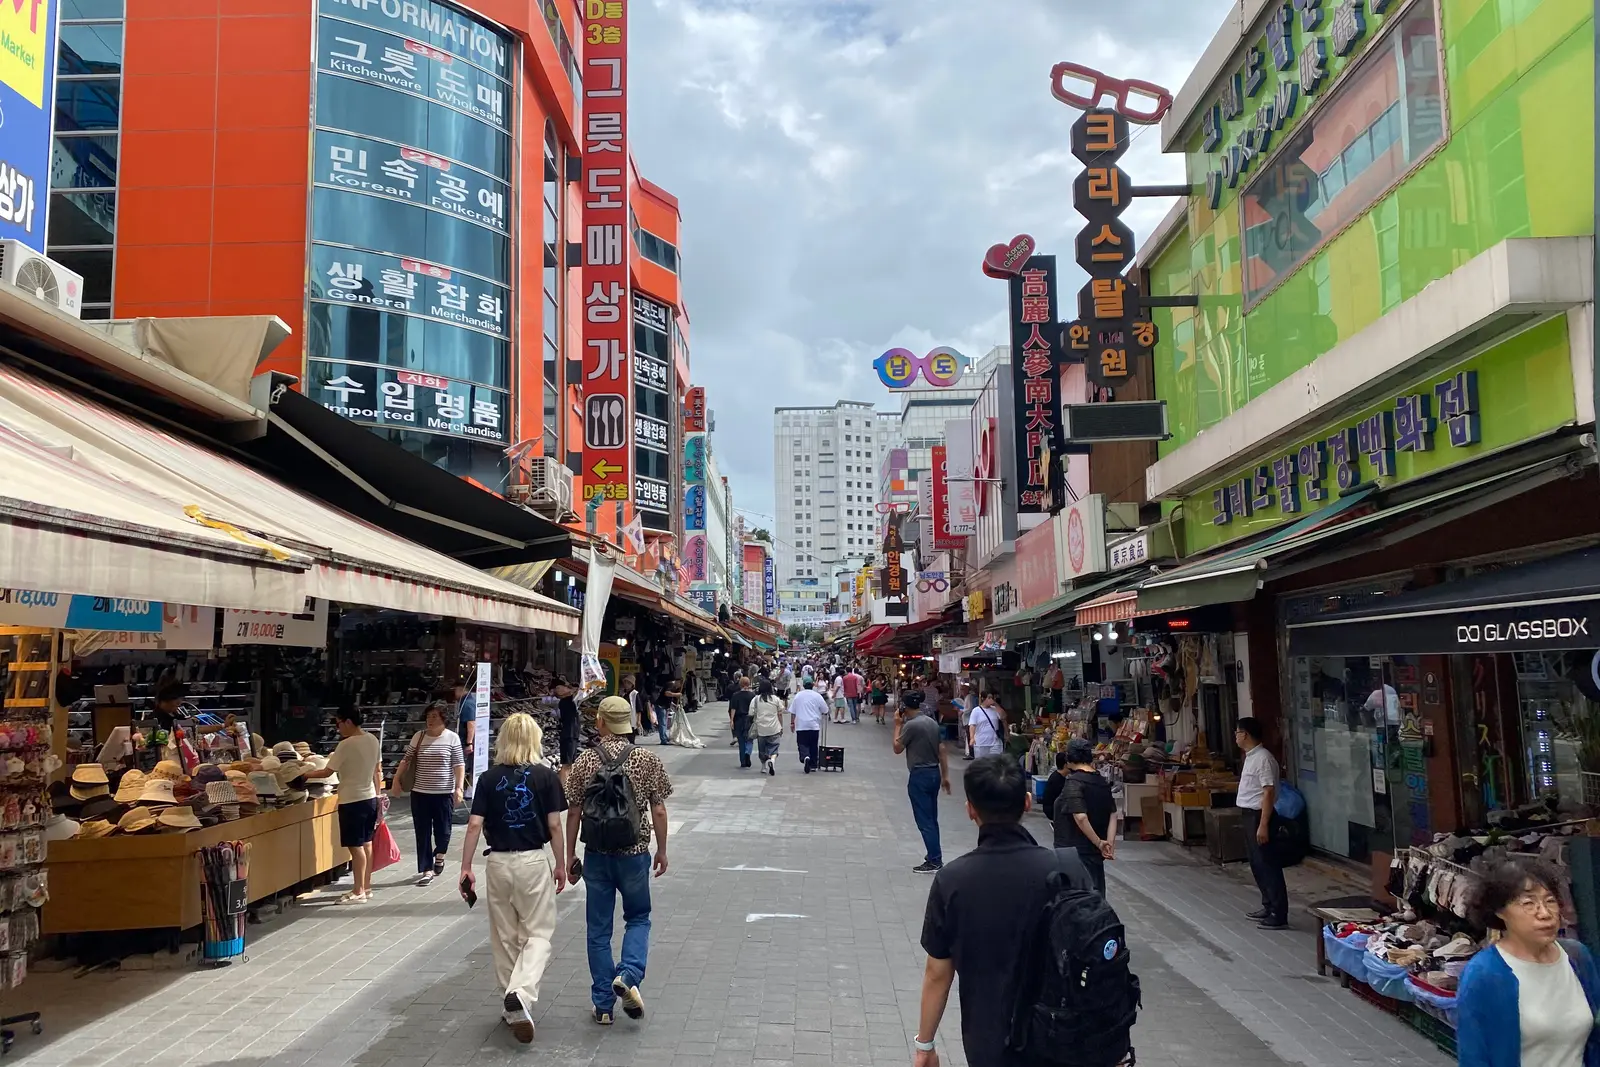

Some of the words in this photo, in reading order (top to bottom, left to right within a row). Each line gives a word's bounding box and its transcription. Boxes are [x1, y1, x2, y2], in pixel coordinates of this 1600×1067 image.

[334, 0, 505, 66] ORMATION
[586, 23, 622, 44] 3층
[1, 29, 35, 70] Market
[330, 58, 422, 92] Kitchenware
[436, 88, 503, 125] Wholesale
[330, 173, 412, 199] Korean
[431, 196, 504, 229] Folkcraft
[1084, 113, 1127, 319] 크리스탈
[586, 57, 626, 381] 그릇도매상가
[1003, 244, 1030, 268] Ginseng
[1005, 237, 1029, 260] Korean
[327, 288, 410, 310] General
[431, 305, 502, 333] Merchandise
[406, 374, 441, 388] 지하
[635, 356, 667, 383] 민속공예
[324, 402, 415, 422] Imported
[427, 417, 502, 439] Merchandise
[636, 418, 667, 442] 생활잡화
[1213, 370, 1481, 526] 크리스탈안경백화점
[635, 480, 667, 502] 수입명품
[113, 599, 150, 617] 14,000
[1484, 617, 1589, 643] GLASSBOX
